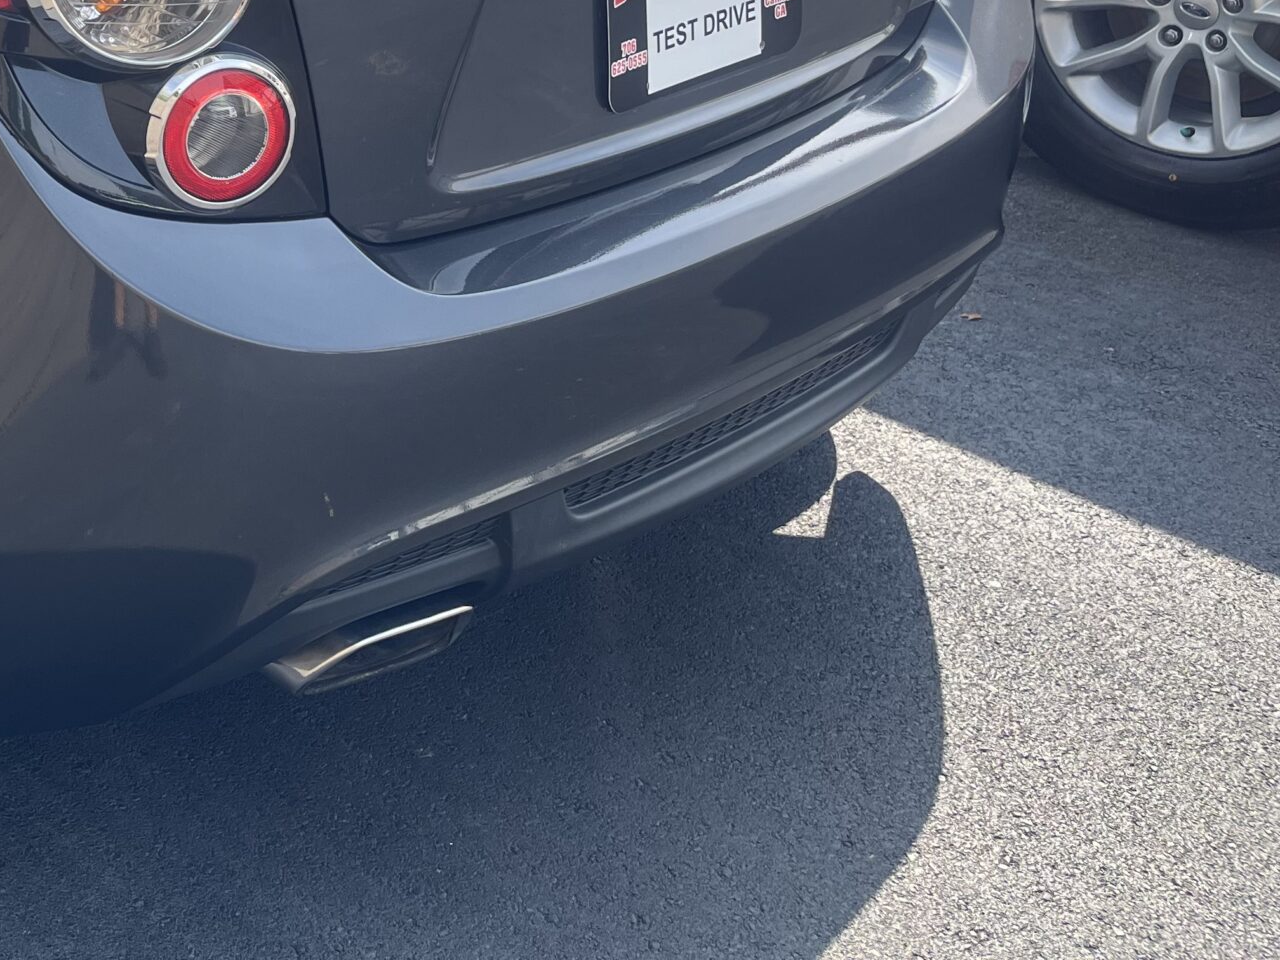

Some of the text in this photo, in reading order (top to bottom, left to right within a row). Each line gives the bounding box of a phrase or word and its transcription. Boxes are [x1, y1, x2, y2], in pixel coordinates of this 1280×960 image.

[774, 3, 787, 19] GA
[653, 0, 756, 53] TEST DRIVE
[621, 39, 637, 57] 706
[611, 50, 647, 77] 625-0555
